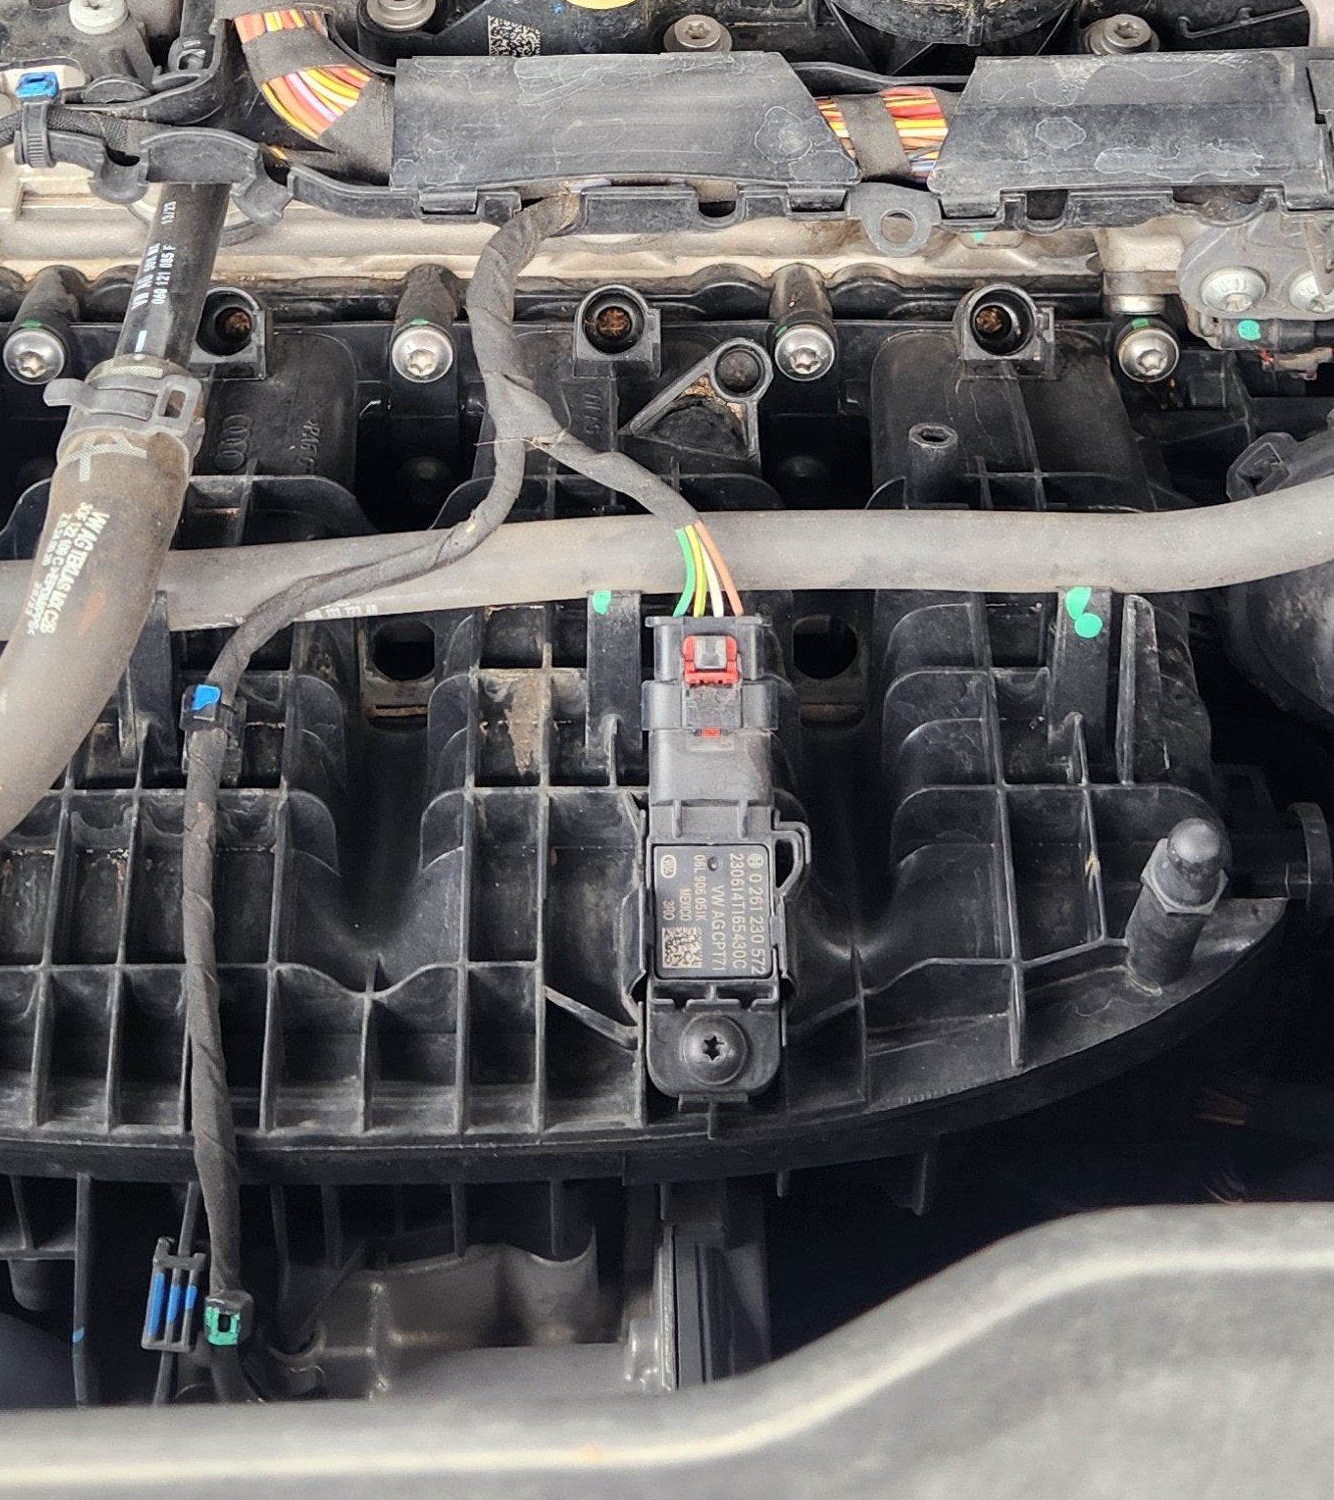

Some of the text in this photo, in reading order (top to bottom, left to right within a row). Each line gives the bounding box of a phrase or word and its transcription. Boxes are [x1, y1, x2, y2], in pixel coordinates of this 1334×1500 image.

[84, 510, 110, 533] VW
[72, 527, 99, 552] AG
[693, 854, 706, 873] 06L
[694, 876, 706, 894] 906
[710, 885, 724, 907] VW
[679, 888, 691, 920] MEXICO
[711, 910, 724, 929] AG
[748, 873, 765, 974] 0 261 230 572
